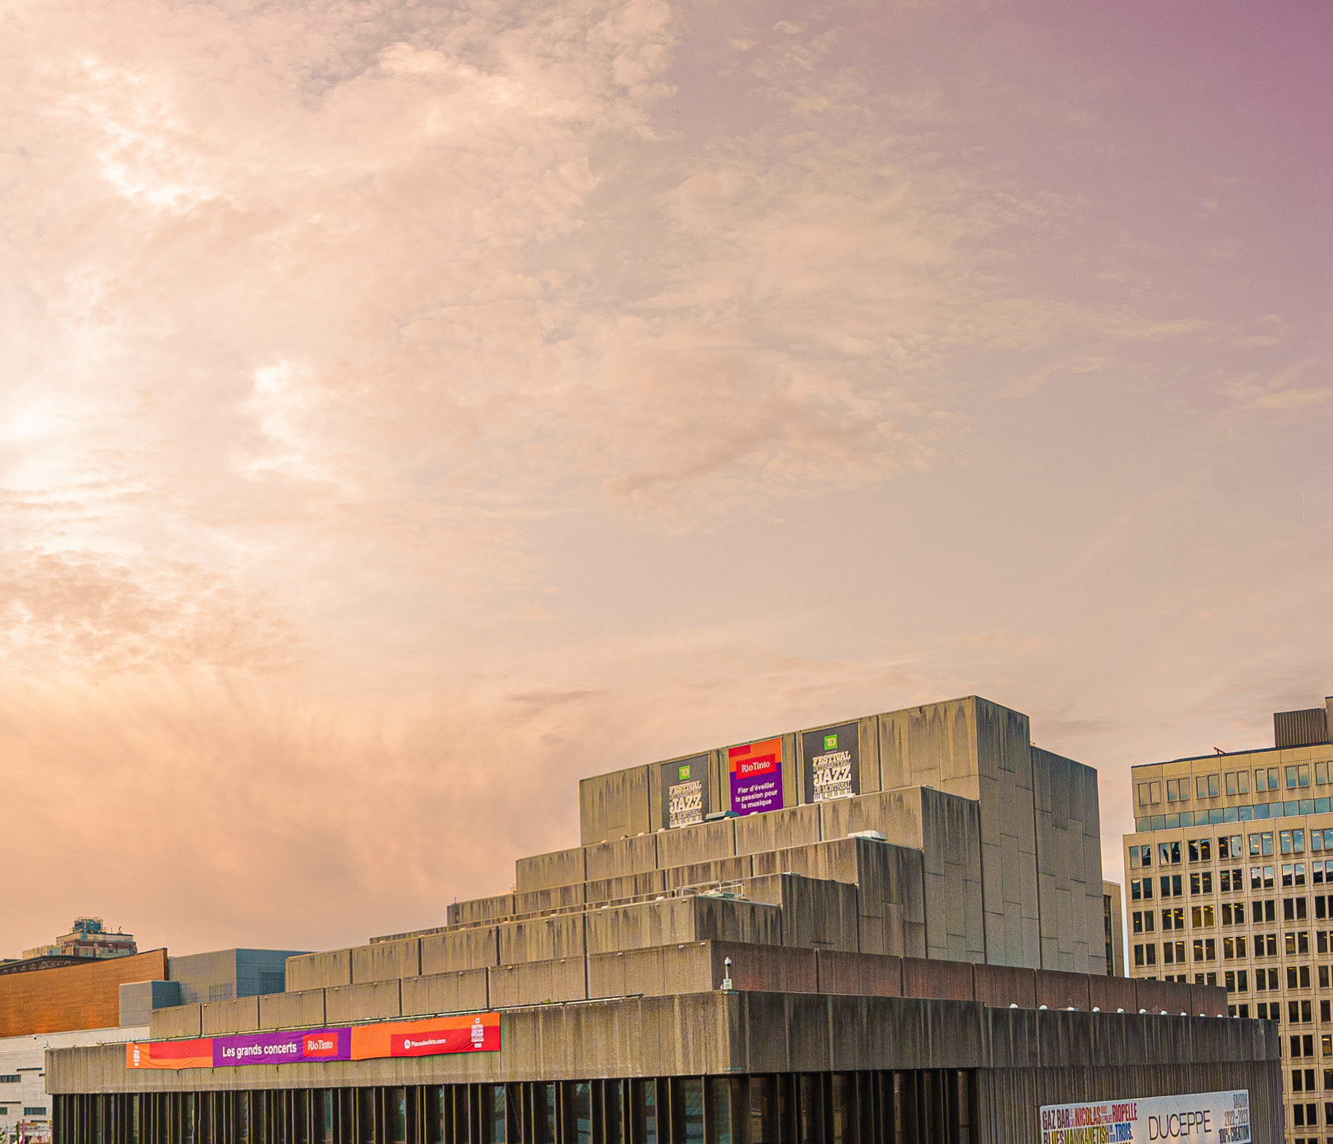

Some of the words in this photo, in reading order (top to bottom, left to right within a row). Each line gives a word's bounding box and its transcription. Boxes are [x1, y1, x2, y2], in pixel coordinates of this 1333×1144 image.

[812, 750, 851, 765] FESTIVAL
[814, 765, 851, 787] JAZZ
[669, 780, 702, 795] FESTIVAL
[742, 792, 763, 802] passion
[765, 789, 779, 798] pour
[670, 793, 702, 814] JAZZ
[748, 799, 772, 808] musique
[222, 1046, 235, 1057] Les
[237, 1043, 262, 1059] grands
[263, 1041, 297, 1055] concerts
[1042, 1109, 1056, 1131] GAZ
[1057, 1108, 1070, 1129] BAR
[1075, 1106, 1101, 1127] NICOLAS
[1112, 1103, 1138, 1123] RIOPELLE
[1148, 1109, 1212, 1141] DUCEPPE
